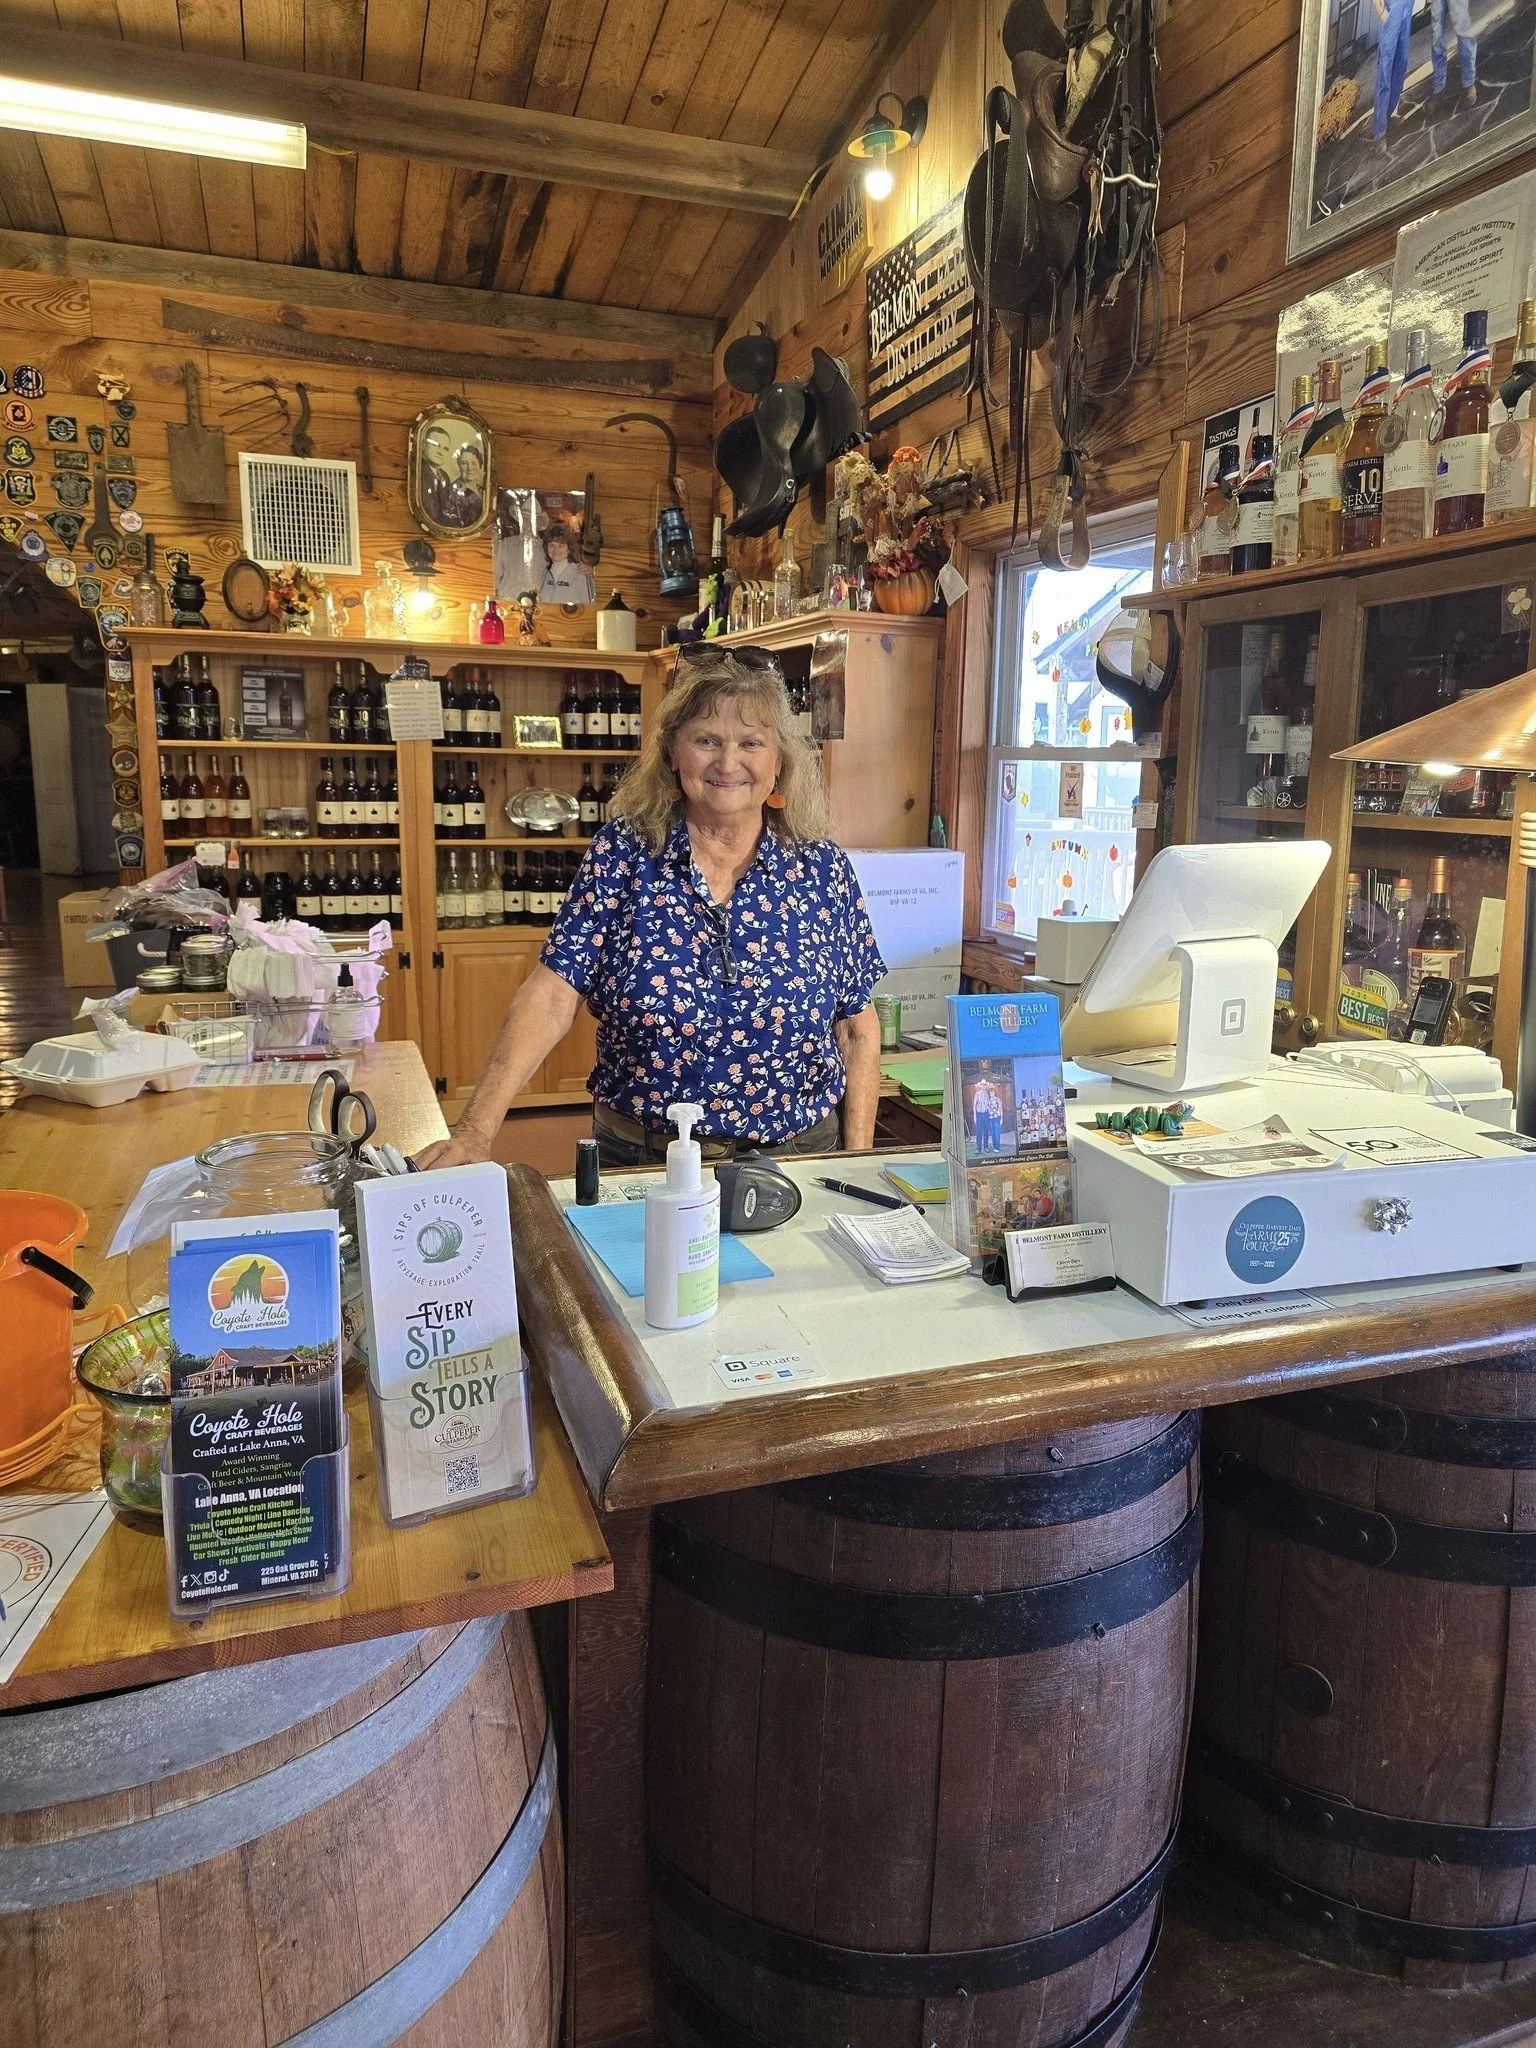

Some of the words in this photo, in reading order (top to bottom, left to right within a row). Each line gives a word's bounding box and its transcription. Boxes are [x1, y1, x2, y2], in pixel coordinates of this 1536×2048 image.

[1415, 239, 1446, 271] AMERICAN
[1446, 224, 1481, 245] DISTILLING
[1481, 220, 1516, 230] INSTITUTE
[1449, 246, 1479, 262] AMERICAN
[1421, 272, 1446, 287] AWARD
[1446, 259, 1478, 276] WINNING
[1479, 247, 1504, 263] SPIRIT
[869, 271, 931, 360] BELMONT
[886, 308, 959, 388] DISTILLERY
[1208, 427, 1238, 443] TASTINGS
[1308, 470, 1327, 479] Kettle
[1393, 464, 1413, 473] Kettle
[1358, 468, 1381, 493] 10
[1051, 839, 1088, 860] AUTUMN
[867, 889, 893, 898] BELMONT
[893, 888, 911, 896] FARMS
[919, 887, 927, 895] VA,
[929, 886, 939, 894] INC.
[970, 1005, 1018, 1017] BELMONT
[1020, 1003, 1048, 1014] FARM
[1340, 996, 1368, 1022] BEST
[982, 1016, 1037, 1029] DISTILLERY
[1367, 1012, 1385, 1027] BEST
[1346, 1139, 1399, 1152] 50
[1164, 1153, 1205, 1164] 50
[393, 1212, 413, 1241] SIPS
[413, 1197, 427, 1213] OF
[433, 1194, 484, 1228] CULPEPER
[1022, 1234, 1053, 1244] BELMONT
[1053, 1232, 1071, 1240] FARM
[1072, 1227, 1107, 1237] DISTILLERY
[1244, 1228, 1274, 1241] FARM
[1277, 1231, 1291, 1246] 25
[1241, 1239, 1272, 1252] TOUR
[396, 1259, 426, 1287] BEVERAGE
[428, 1264, 473, 1288] EXPLORATION
[472, 1243, 485, 1267] TRAIL
[1215, 1299, 1243, 1309] Only
[1243, 1295, 1266, 1305] ONE
[212, 1309, 252, 1331] Coyote
[257, 1305, 287, 1322] Hole
[405, 1299, 474, 1330] EVERY
[1200, 1309, 1243, 1323] Tasting
[1244, 1308, 1263, 1318] per
[1264, 1302, 1313, 1314] customer
[254, 1319, 288, 1328] BEVERAGES
[405, 1326, 456, 1370] SIP
[428, 1349, 482, 1386] TELLS
[484, 1353, 494, 1370] A
[749, 1354, 800, 1369] Square
[409, 1374, 498, 1430] STORY
[189, 1408, 250, 1445] Coyote
[257, 1401, 304, 1429] Hole
[225, 1430, 254, 1440] CRAFT
[254, 1423, 303, 1437] BEVERAGES
[434, 1425, 481, 1443] CULPEPER
[192, 1444, 228, 1458] Crafted
[228, 1444, 238, 1453] at
[239, 1441, 261, 1452] Lake
[262, 1439, 291, 1449] Anna,
[291, 1435, 306, 1444] VA
[221, 1455, 246, 1467] Award
[246, 1452, 280, 1463] Winning
[211, 1468, 231, 1478] Hard
[260, 1460, 292, 1472] Sangrias
[218, 1479, 236, 1488] Beer
[245, 1473, 283, 1484] Mountain
[283, 1469, 306, 1478] Water
[195, 1495, 219, 1509] Lake
[219, 1492, 248, 1504] Anna,
[248, 1488, 262, 1500] VA
[262, 1483, 304, 1498] Location
[232, 1504, 249, 1514] Hole
[249, 1502, 267, 1512] Craft
[267, 1499, 294, 1509] Kitchen
[190, 1522, 209, 1532] Trivia
[214, 1516, 243, 1528] Comedy
[244, 1513, 263, 1524] Night
[267, 1510, 282, 1520] Line
[282, 1506, 311, 1518] Dancing
[186, 1533, 201, 1542] Live
[228, 1524, 256, 1535] Outdoor
[256, 1520, 282, 1531] Movies
[285, 1516, 314, 1527] Karaoke
[189, 1540, 219, 1552] Haunted
[293, 1526, 313, 1536] Show
[193, 1551, 206, 1561] Car
[206, 1547, 231, 1558] Shows
[234, 1542, 266, 1554] Festivals
[270, 1539, 292, 1550] Happy
[292, 1535, 309, 1545] Hour
[0, 1536, 45, 1582] ERTIFIED
[218, 1556, 238, 1567] Fresh
[240, 1553, 260, 1564] Cider
[260, 1549, 285, 1560] Donuts
[260, 1566, 275, 1576] 225
[275, 1565, 289, 1573] Oak
[289, 1562, 309, 1572] Grove
[310, 1559, 319, 1568] Dr.
[260, 1575, 290, 1586] Mineral,
[290, 1573, 300, 1581] VA
[300, 1569, 319, 1579] 23117
[181, 1582, 239, 1599] CoyoteHole.com
